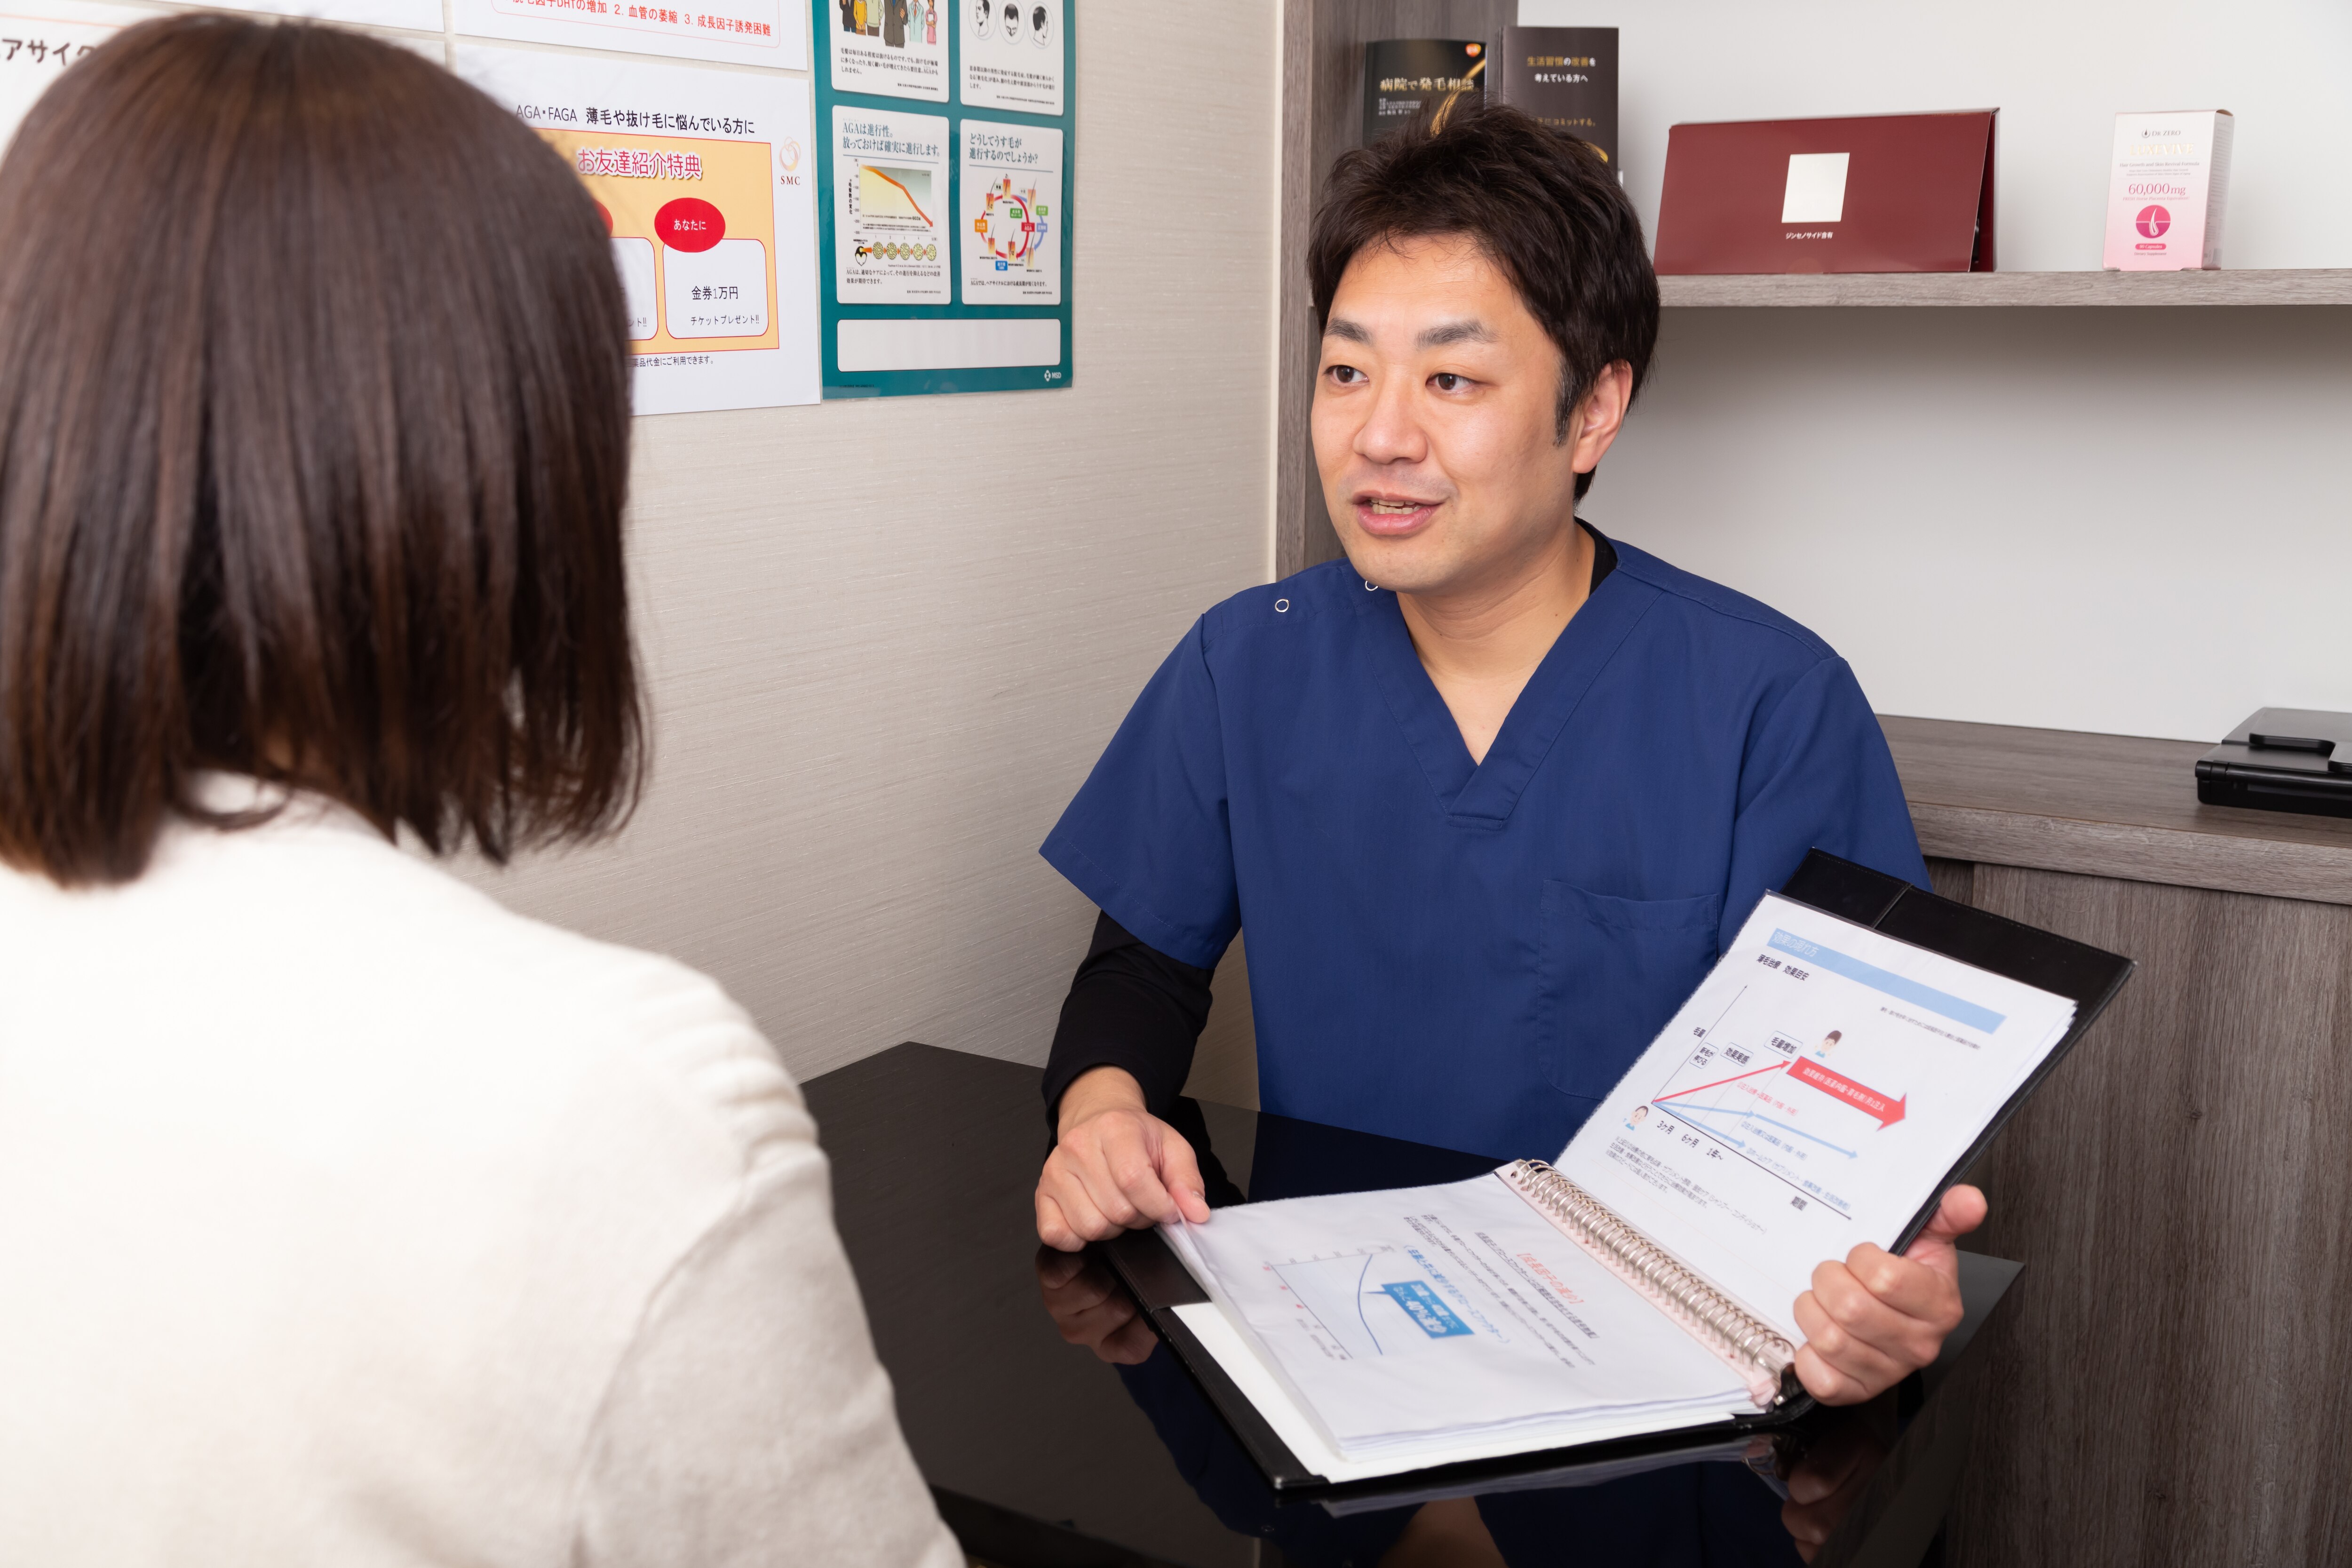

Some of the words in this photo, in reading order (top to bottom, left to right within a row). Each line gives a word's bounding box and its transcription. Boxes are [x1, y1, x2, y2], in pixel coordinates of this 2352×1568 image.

[513, 0, 607, 13] 因子DHTの増加
[628, 5, 678, 24] 血管の萎縮
[697, 15, 771, 37] 成長因子誘発困難
[1534, 73, 1589, 83] 考えている方へ
[586, 107, 755, 135] 薄毛や抜け毛に悩んでいる方に
[842, 122, 893, 138] AGAは進行性。
[842, 136, 940, 157] 放っておけば確実に進行します。
[969, 132, 1022, 149] どうしてうす毛が
[577, 148, 702, 179] お友達紹介特典
[780, 175, 801, 185] SMC
[674, 219, 707, 231] あなたに
[691, 285, 739, 301] 金券1万円
[690, 314, 760, 326] チケットプレゼント!!
[627, 355, 714, 368] 薬品代金にご利用できます。
[1769, 930, 1821, 957] 効果の現れ方
[1756, 953, 1782, 970] 薄毛治療
[1782, 964, 1810, 981] 効果目安
[1692, 1026, 1706, 1038] 毛量
[1769, 1036, 1797, 1054] 毛量増加
[1724, 1046, 1750, 1065] 効果実感
[1789, 1195, 1808, 1211] 期間
